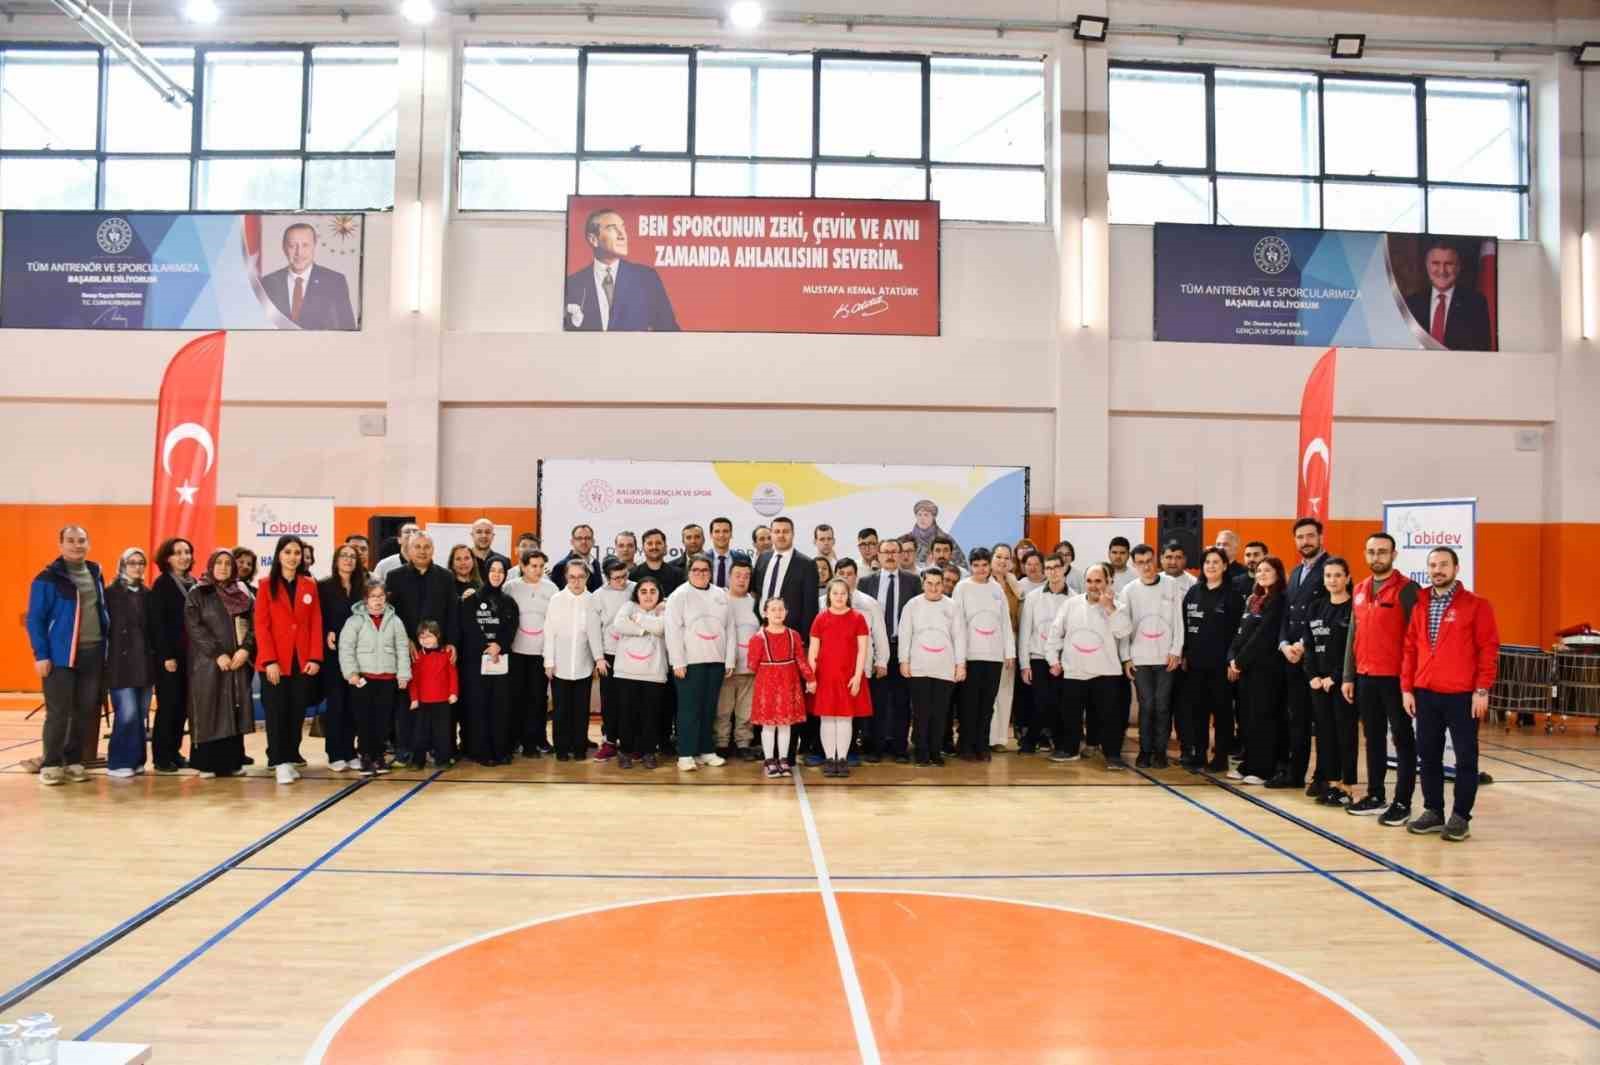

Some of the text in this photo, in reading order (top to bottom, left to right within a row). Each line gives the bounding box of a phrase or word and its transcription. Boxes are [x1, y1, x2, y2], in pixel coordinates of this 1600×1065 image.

[638, 211, 920, 244] BEN SPORCUNUN ZEKİ, ÇEVİK VE AYNI
[654, 243, 903, 270] ZAMANDA AHLAKLISINI SEVERİM.
[26, 261, 49, 272] TÜM
[51, 262, 102, 273] ANTRENÖR
[104, 263, 115, 273] VE
[802, 285, 919, 296] MUSTAFA KEMAL ATATÜRK
[1180, 282, 1361, 300] TÜM ANTRENÖR VE SPORCULARIMIZA
[1225, 299, 1319, 309] BAŞARILAR DİLİYORUM
